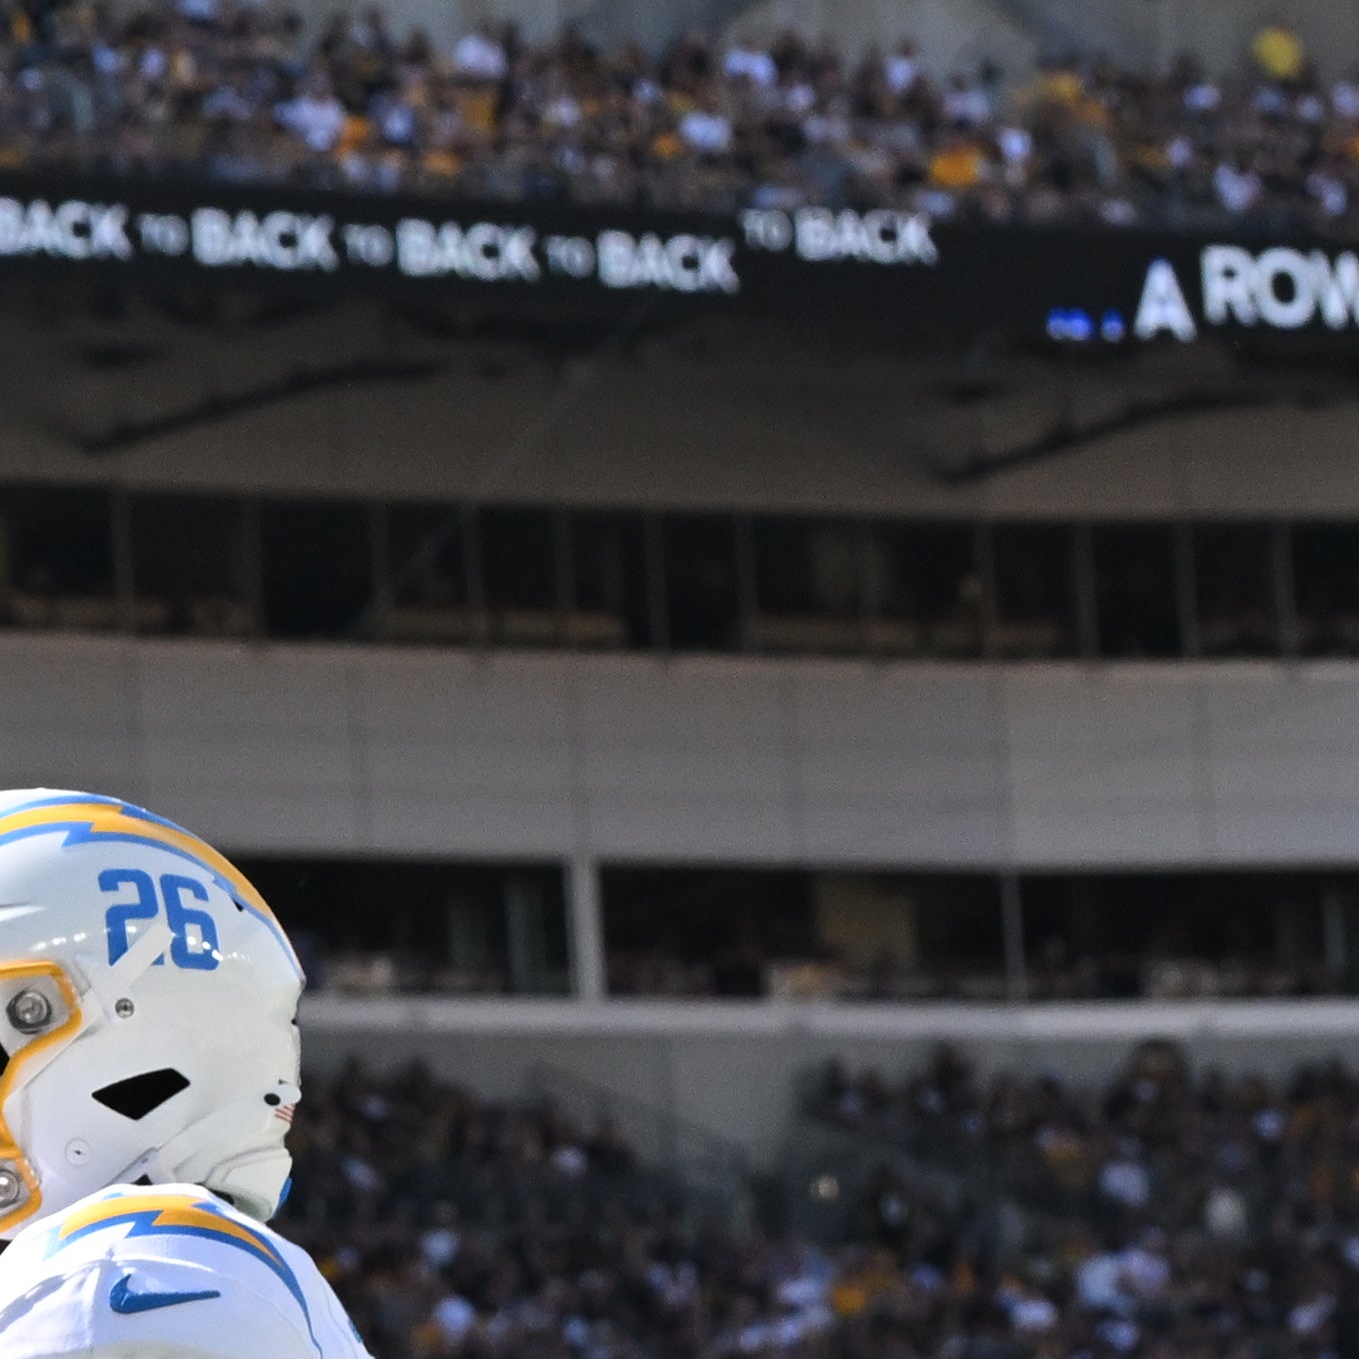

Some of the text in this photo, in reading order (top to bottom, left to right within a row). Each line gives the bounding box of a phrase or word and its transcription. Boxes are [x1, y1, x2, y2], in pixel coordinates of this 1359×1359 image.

[139, 214, 188, 254] TO
[191, 207, 337, 269] BACK
[345, 224, 393, 265] TO
[396, 219, 539, 280] BACK
[547, 236, 595, 276] TO
[597, 230, 738, 291] BACK
[743, 207, 793, 250] TO
[795, 206, 939, 262] BACK
[1135, 261, 1195, 340] A
[98, 868, 221, 970] 26
